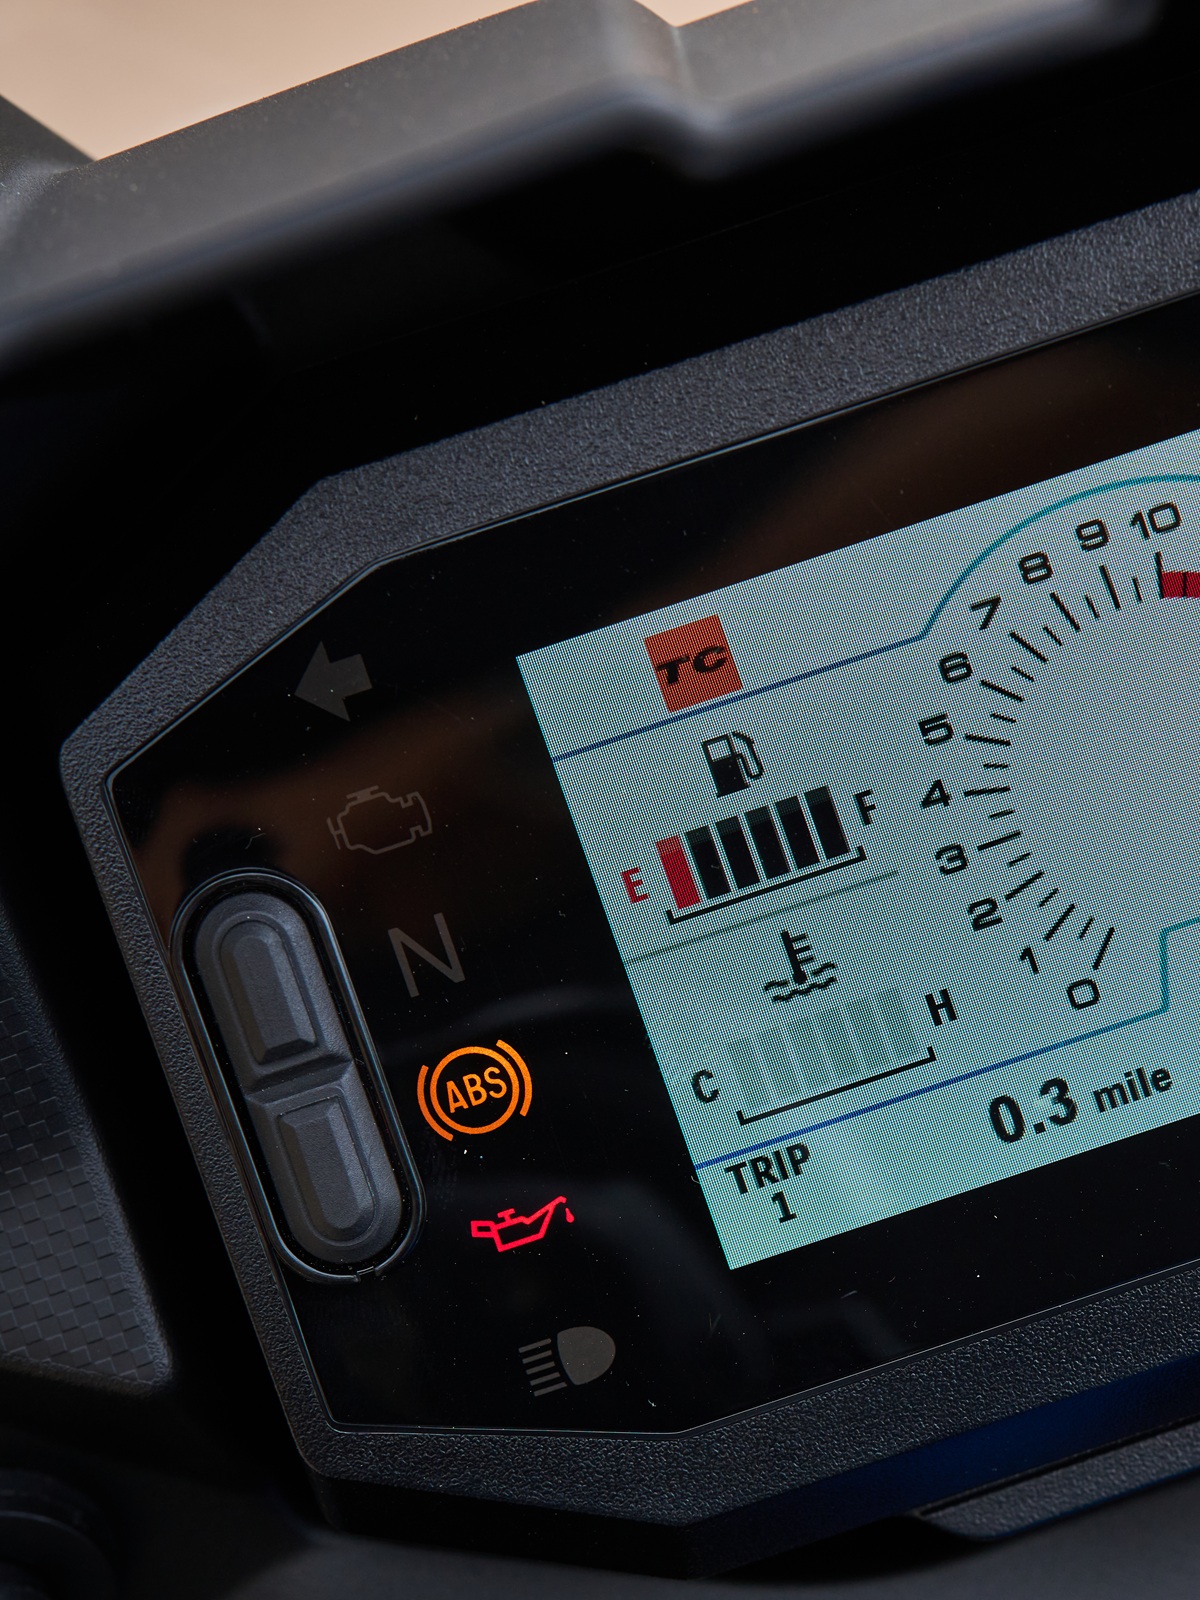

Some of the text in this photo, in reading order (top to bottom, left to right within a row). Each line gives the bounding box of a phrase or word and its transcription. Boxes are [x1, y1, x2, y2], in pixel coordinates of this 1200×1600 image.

[1076, 520, 1109, 550] 9
[1131, 502, 1182, 539] 10
[1019, 552, 1053, 583] 8
[971, 597, 1001, 630] 7
[656, 646, 728, 686] TC
[939, 652, 972, 682] 6
[919, 713, 954, 745] 5
[854, 790, 877, 826] F
[921, 780, 951, 808] 4
[935, 844, 968, 875] 3
[621, 867, 648, 903] E
[968, 901, 1003, 931] 2
[387, 912, 465, 997] N
[1019, 947, 1041, 974] 1
[925, 989, 957, 1026] H
[1067, 979, 1099, 1009] 0
[445, 1066, 508, 1114] ABS
[691, 1069, 719, 1103] C
[989, 1066, 1173, 1144] 0.3 mile
[725, 1144, 810, 1194] TRIP
[771, 1191, 796, 1223] 1
